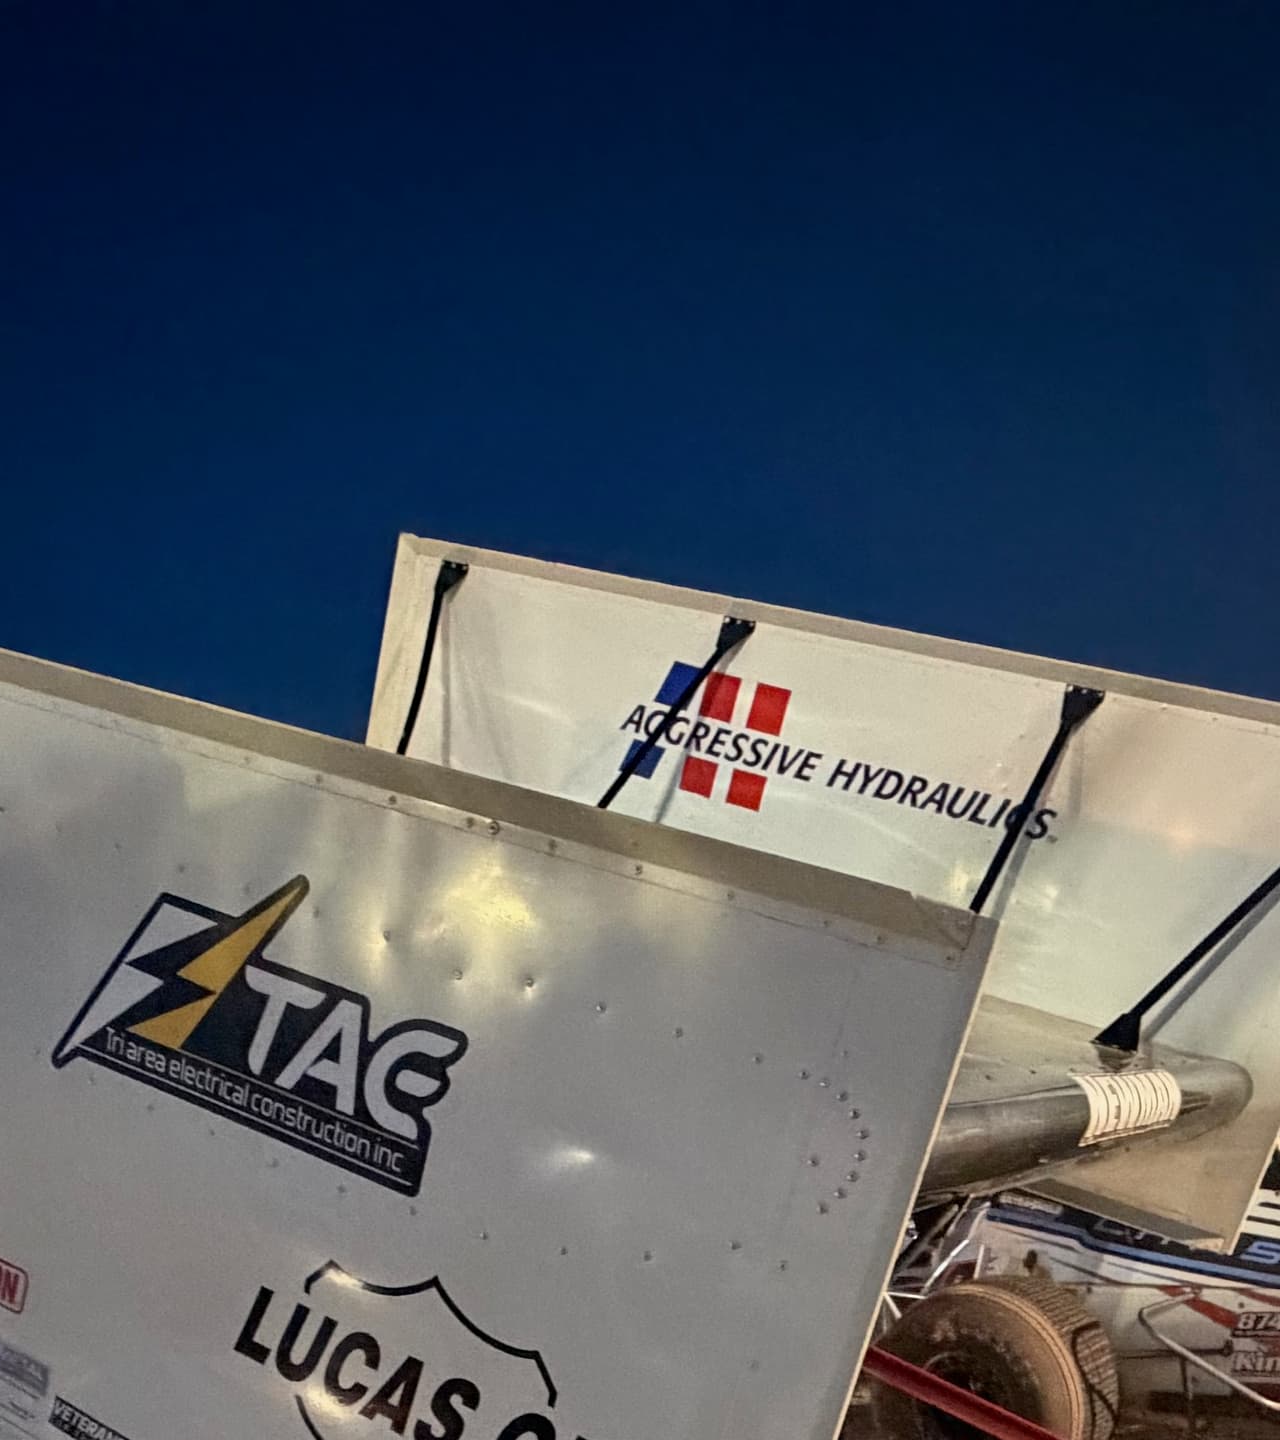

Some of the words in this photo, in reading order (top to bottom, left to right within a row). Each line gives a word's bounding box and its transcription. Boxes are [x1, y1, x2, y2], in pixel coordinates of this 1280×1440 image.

[620, 704, 823, 782] AGGRESSIVE
[104, 1026, 126, 1054] Tri
[125, 1040, 167, 1074] area
[169, 1056, 251, 1108] electrical
[250, 1092, 371, 1160] construction
[372, 1136, 405, 1173] inc
